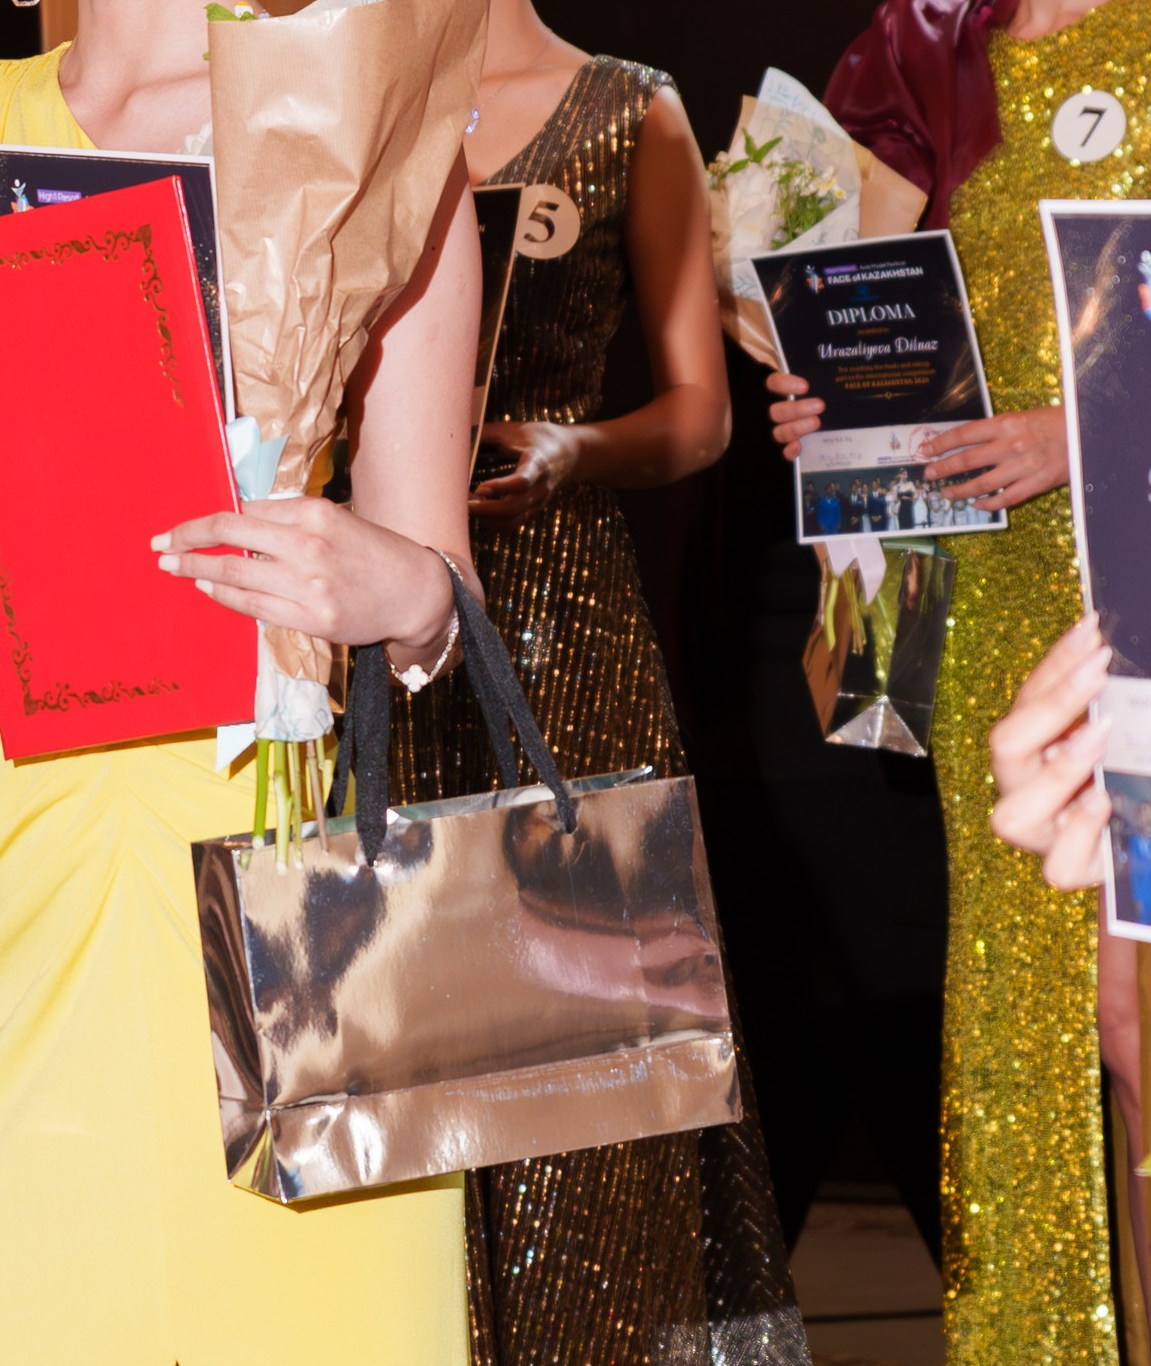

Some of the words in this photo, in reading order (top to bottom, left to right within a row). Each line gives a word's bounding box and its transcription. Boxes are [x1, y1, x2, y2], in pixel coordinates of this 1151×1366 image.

[1079, 107, 1107, 147] 7
[524, 201, 559, 243] 5
[827, 303, 916, 326] DIPLOMA
